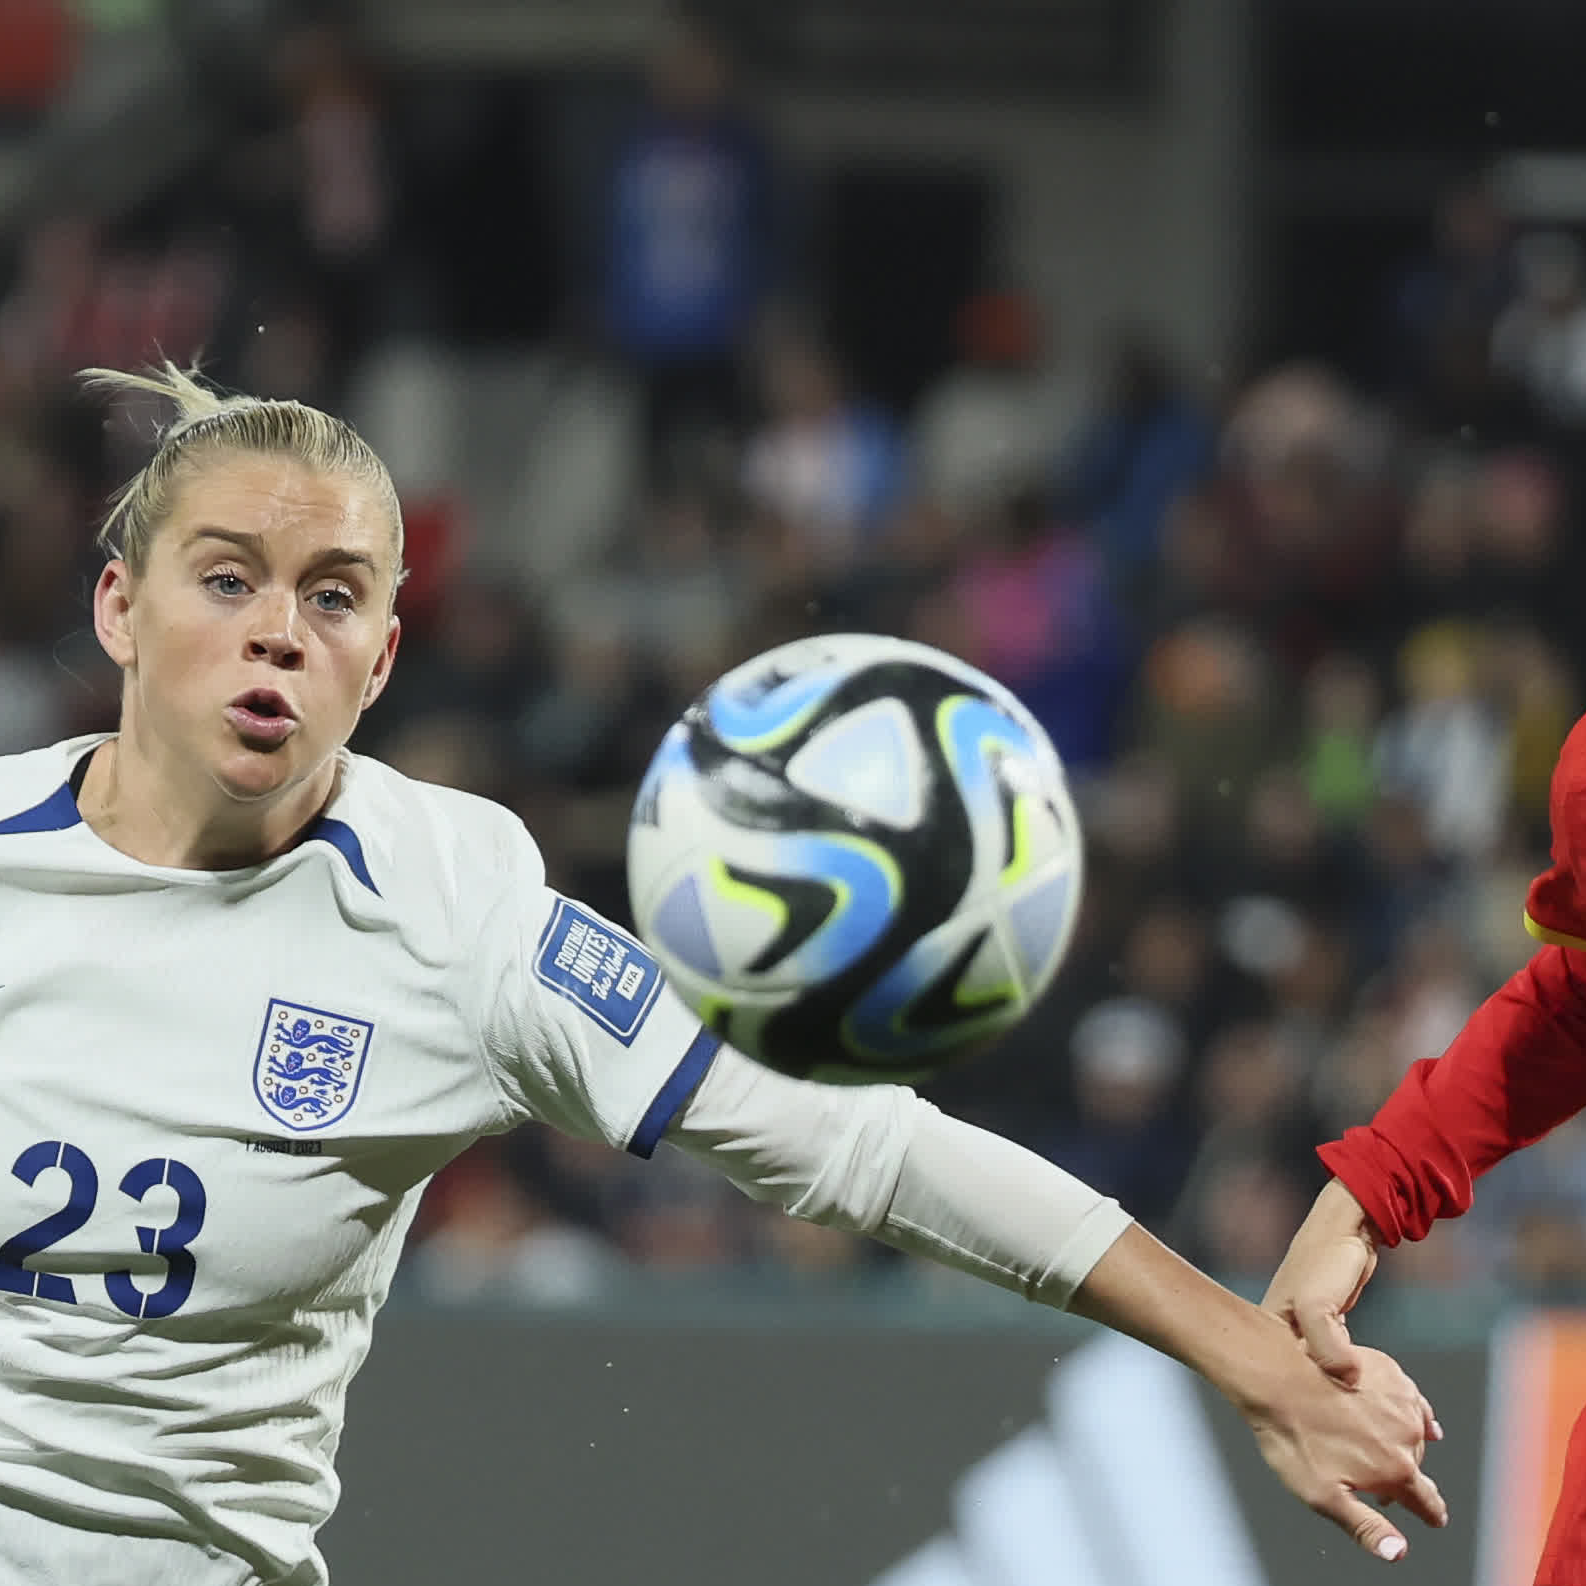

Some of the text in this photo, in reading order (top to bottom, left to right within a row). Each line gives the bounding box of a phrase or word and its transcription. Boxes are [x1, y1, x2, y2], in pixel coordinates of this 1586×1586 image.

[554, 919, 589, 971] FOOTBALL
[569, 928, 610, 984] UNITES
[591, 938, 630, 1000] the World
